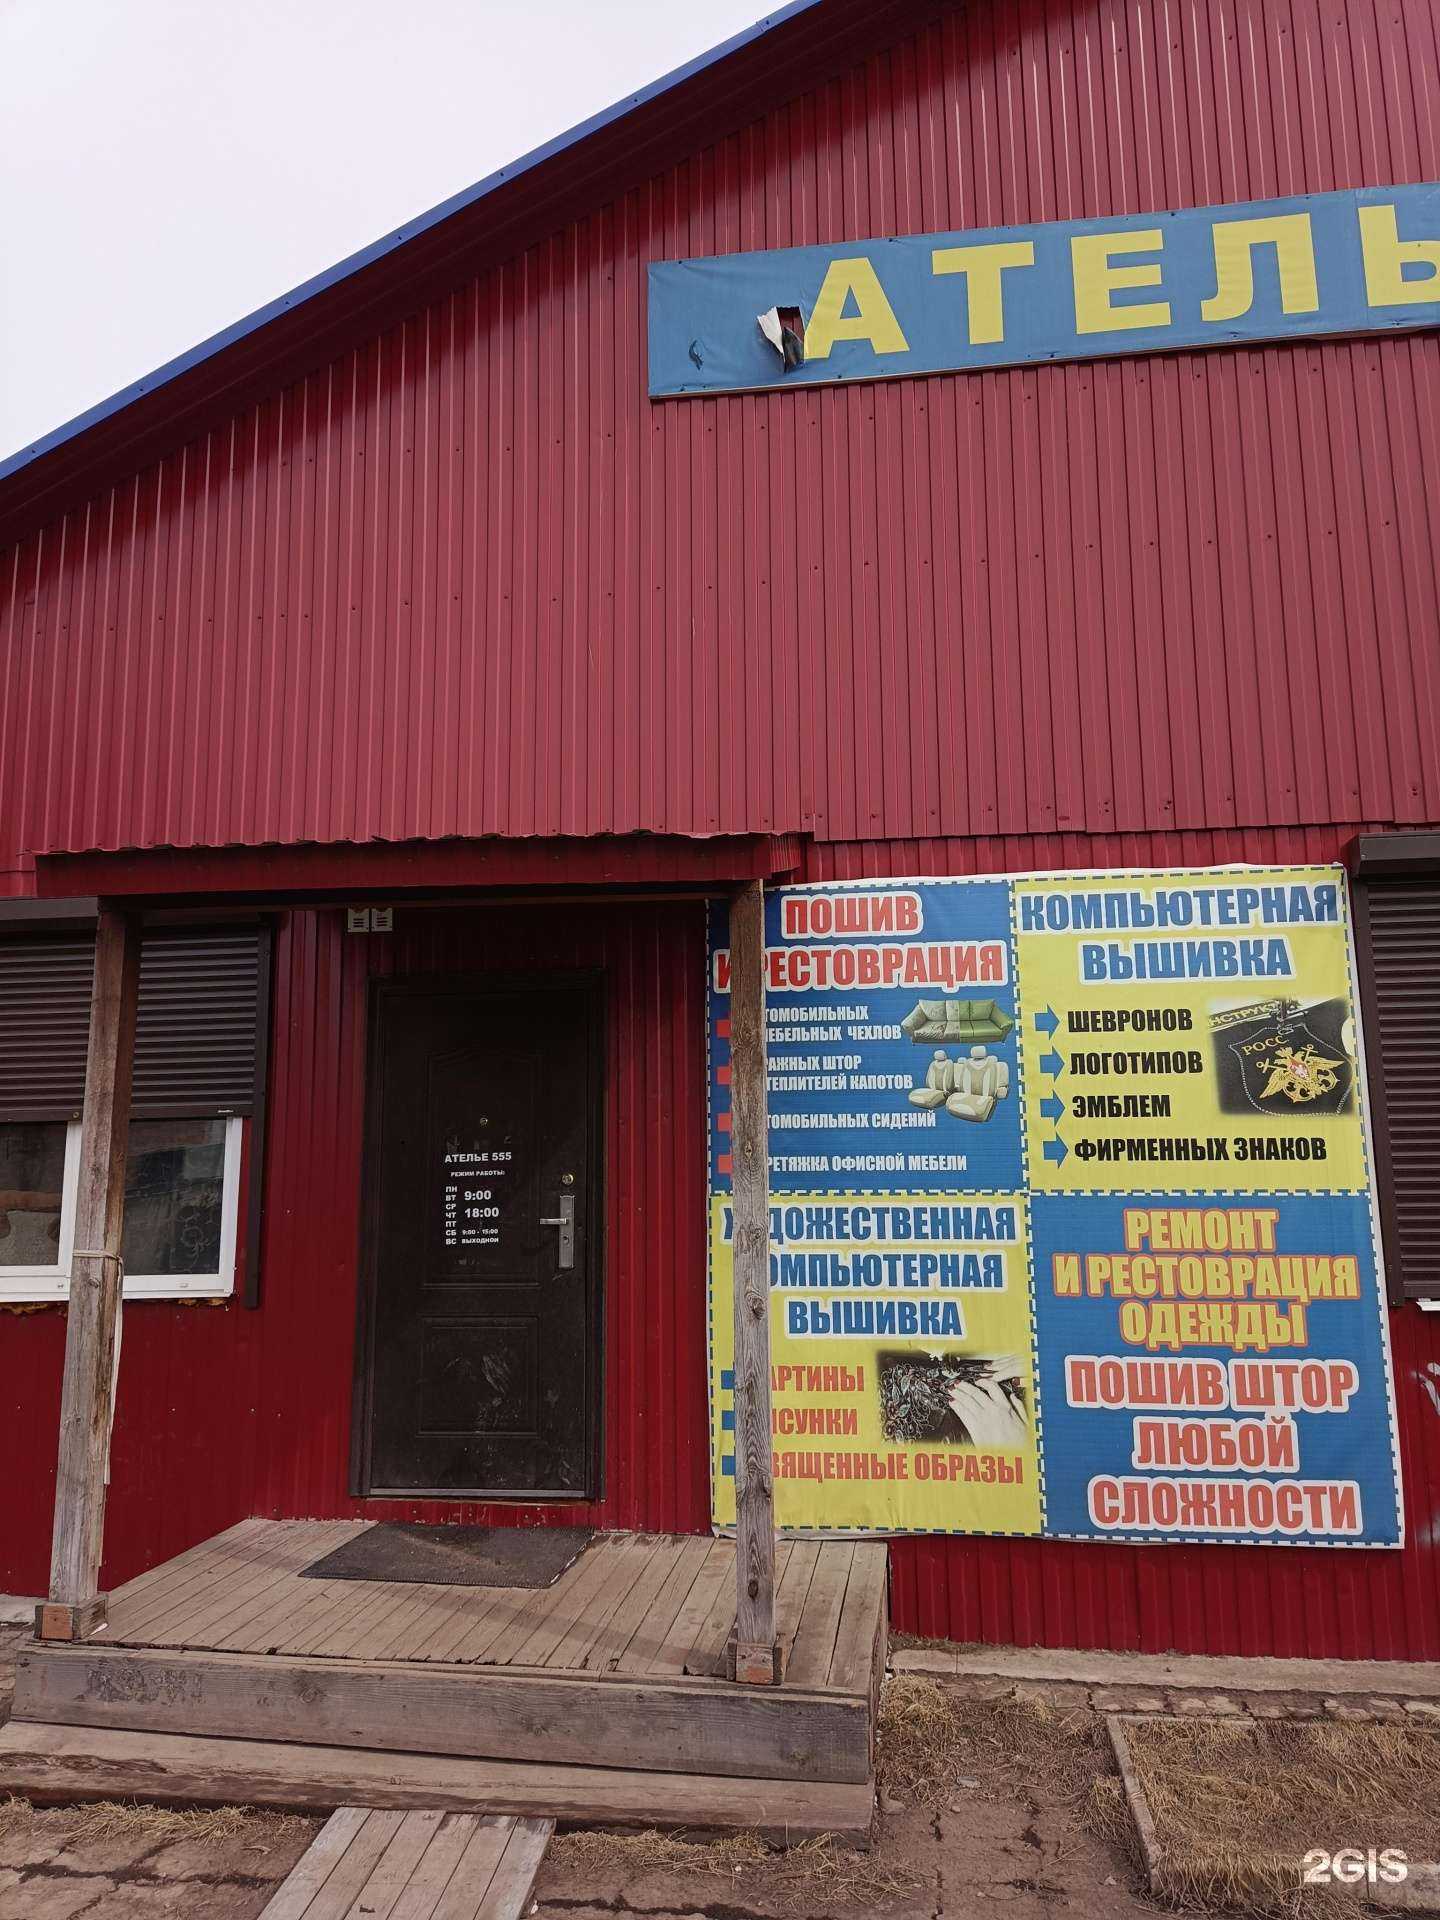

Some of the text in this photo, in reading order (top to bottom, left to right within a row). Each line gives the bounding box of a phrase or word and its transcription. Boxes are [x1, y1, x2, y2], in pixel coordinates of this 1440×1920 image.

[801, 204, 1440, 360] АТЕЛЬ
[786, 895, 919, 935] ПОШИВ
[1021, 885, 1338, 931] КОМПЬЮТЕРНАЯ
[764, 945, 1004, 988] ЕСТОВРАЦИЯ
[1082, 938, 1292, 981] ВЫШИВКА
[765, 1005, 869, 1023] ТОМОБИЛЬНЫХ
[1067, 1008, 1193, 1033] ШЕВРОНОВ
[766, 1024, 902, 1042] ЕБЕЛЬНЫХ ЧЕХЛОВ
[766, 1055, 862, 1072] АЖНЫХ ШТОР
[1070, 1051, 1203, 1075] ЛОГОТИПОВ
[766, 1073, 847, 1092] ТЕПЛИТЕЛЕЙ
[767, 1110, 936, 1130] ТОМОБИЛЬНЫХ СИДЕНИЙ
[1072, 1095, 1171, 1118] ЭМБЛЕМ
[444, 1152, 512, 1163] АТЕЛЬЕ 555
[767, 1152, 967, 1173] РЕТЯЖКА ОФИСНОЙ МЕБЕЛИ
[1074, 1137, 1327, 1161] ФИРМЕННЫХ ЗНАКОВ
[464, 1190, 491, 1200] 9:00
[464, 1207, 499, 1218] 18:00
[1125, 1209, 1278, 1251] РЕМОНТ
[769, 1253, 1004, 1288] МПЬЮТЕРНАЯ
[1054, 1255, 1359, 1302] И РЕСТОВРАЦИЯ
[788, 1301, 963, 1335] ВЫШИВКА
[1120, 1301, 1307, 1350] ОДЕЖДЫ
[771, 1365, 865, 1392] РТИНЫ
[1069, 1360, 1354, 1408] ПОШИВ ШТОР
[771, 1408, 858, 1435] СУНКИ
[1137, 1415, 1294, 1467] ЛЮБОЙ
[771, 1451, 1024, 1484] ВЯЩЕННЫЕ ОБРАЗЫ
[1093, 1480, 1357, 1529] СЛОЖНОСТИ
